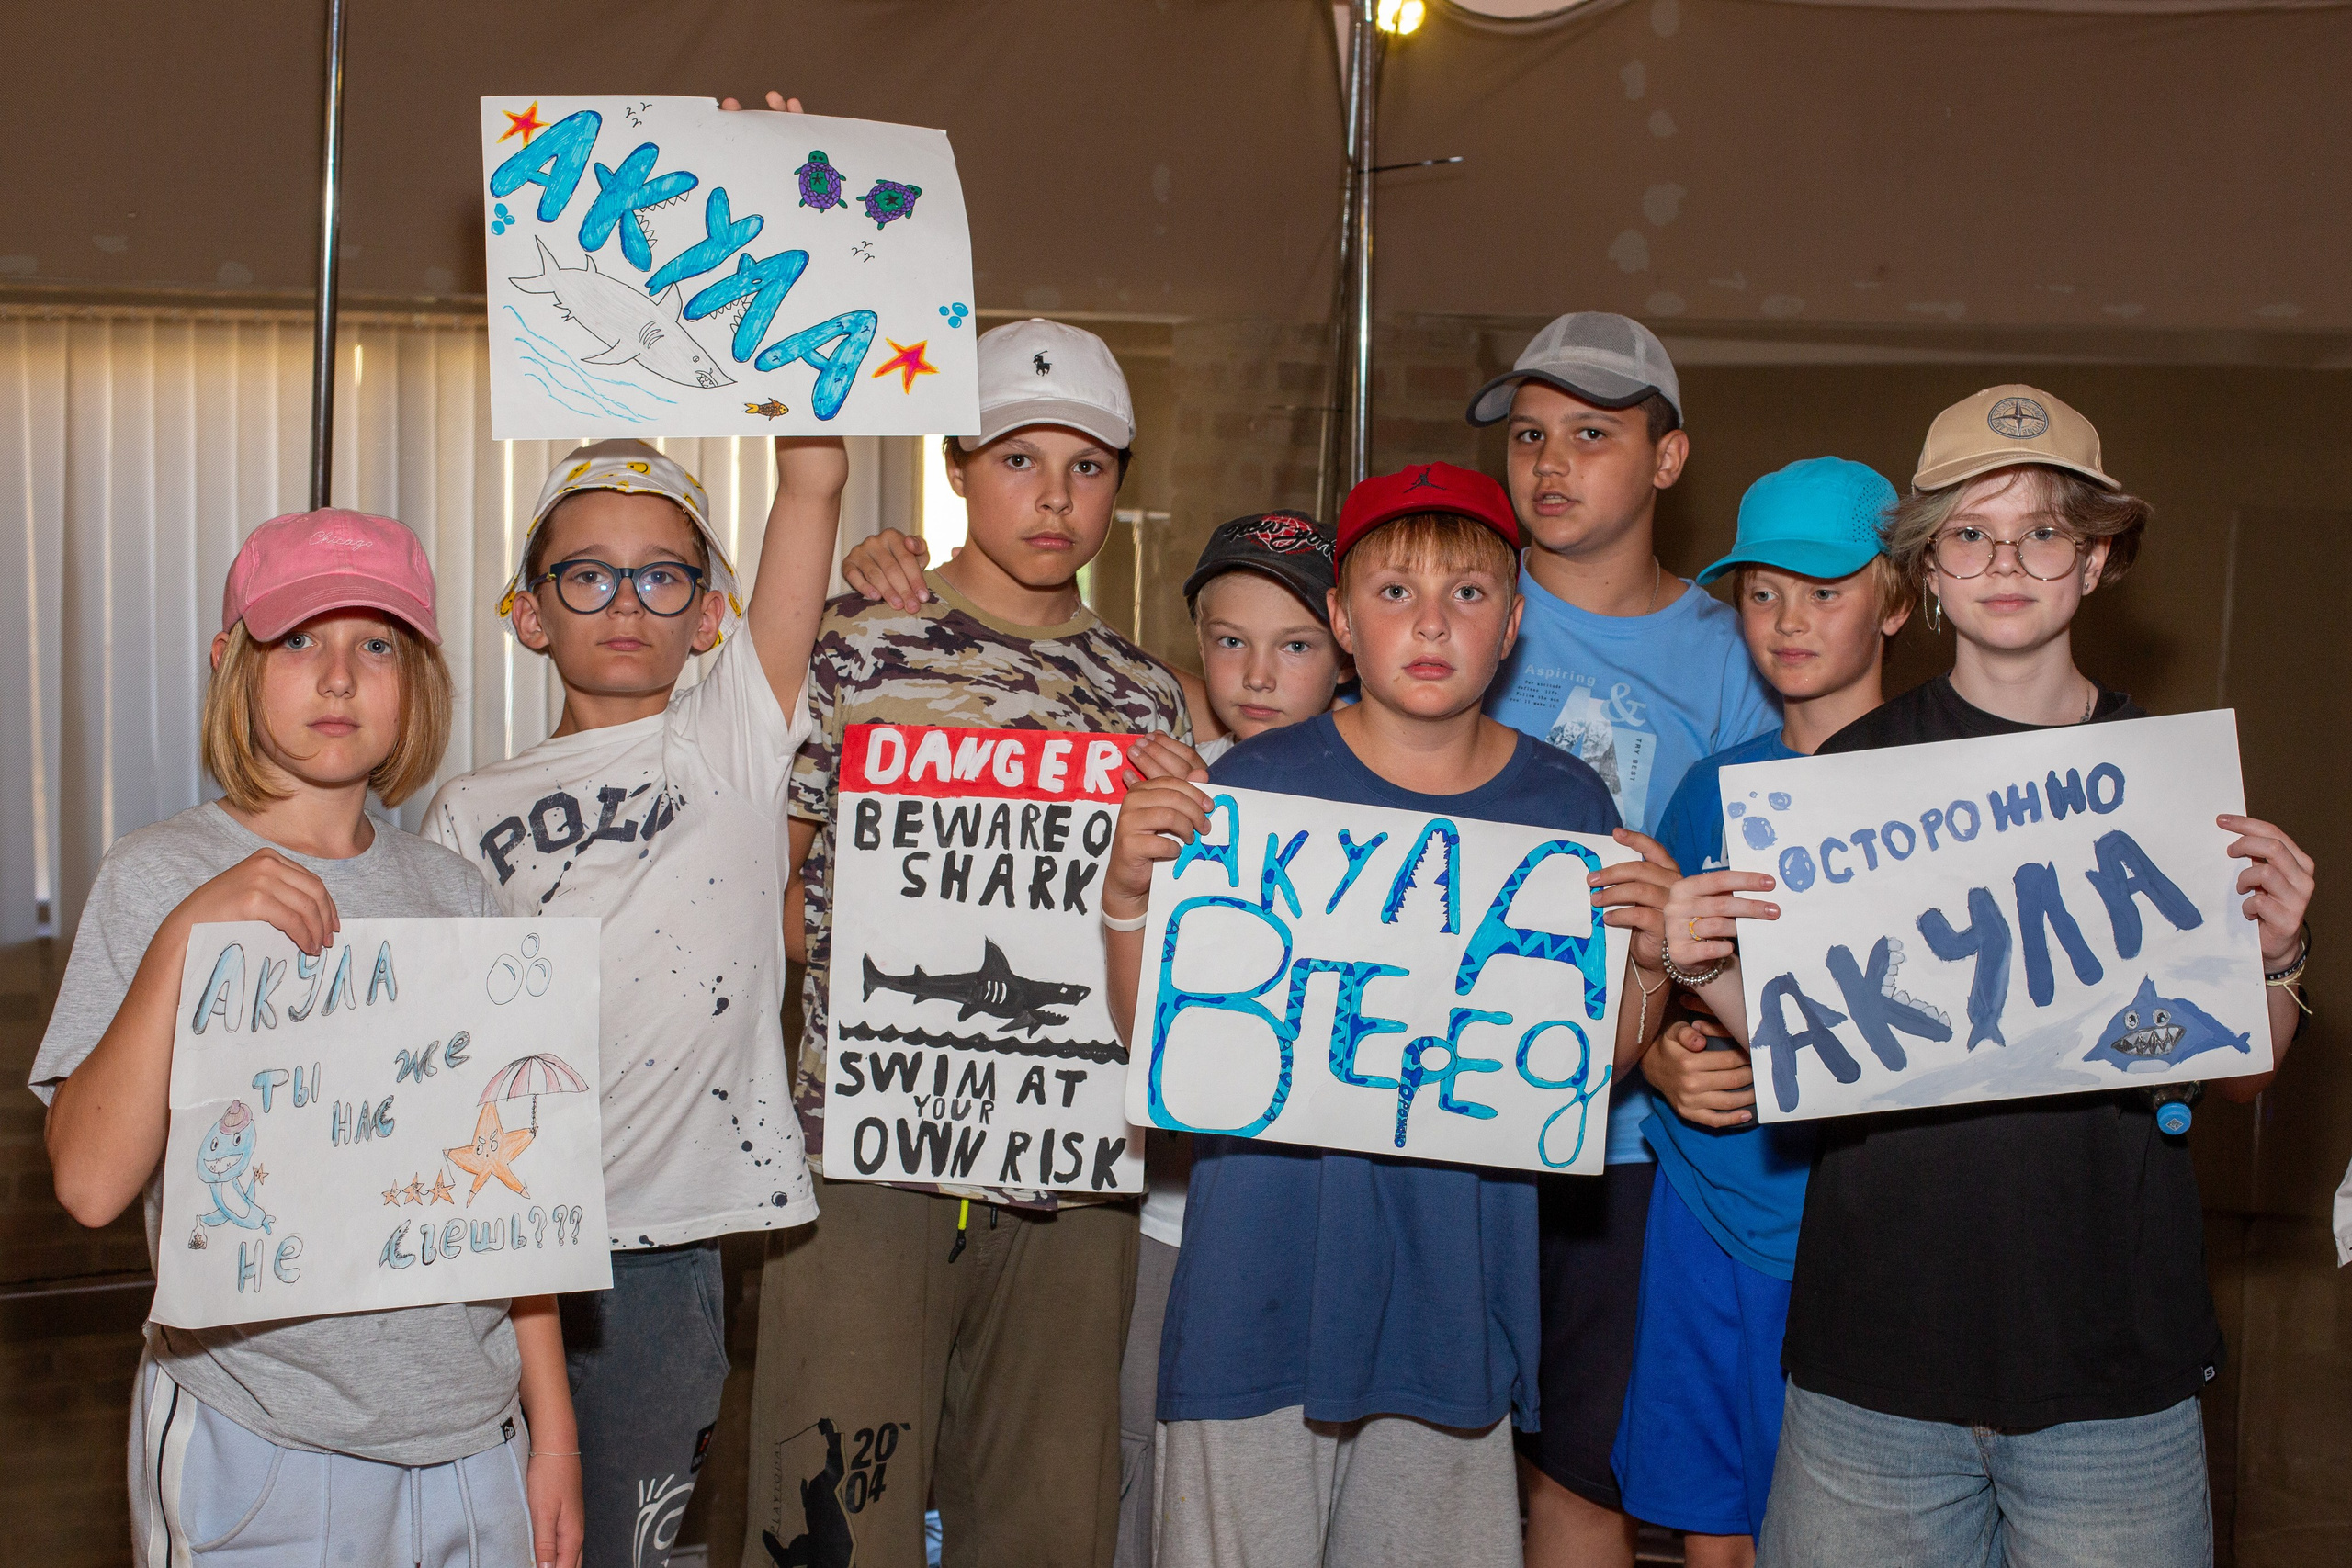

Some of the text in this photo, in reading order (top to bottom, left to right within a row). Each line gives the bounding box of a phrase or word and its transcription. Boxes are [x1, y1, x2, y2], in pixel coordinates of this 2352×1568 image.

[490, 109, 878, 422] АКУЛА
[309, 531, 373, 551] Chicago
[1524, 664, 1597, 688] Aspiring
[864, 728, 1123, 794] DANGER
[1629, 739, 1643, 782] TRY BEST
[854, 799, 1113, 858] BEWARE O
[1778, 761, 2126, 893] ОСТОРОЖНО
[900, 851, 1100, 917] SHARK
[1172, 794, 1607, 1020] АКУЛА
[192, 940, 398, 1035] АКУЛА
[1749, 829, 2203, 1113] АКУЛА
[834, 1051, 1088, 1108] SWIM AT
[913, 1095, 996, 1126] YOUR
[853, 1116, 1126, 1192] OWN RISK
[845, 1462, 887, 1514] 04
